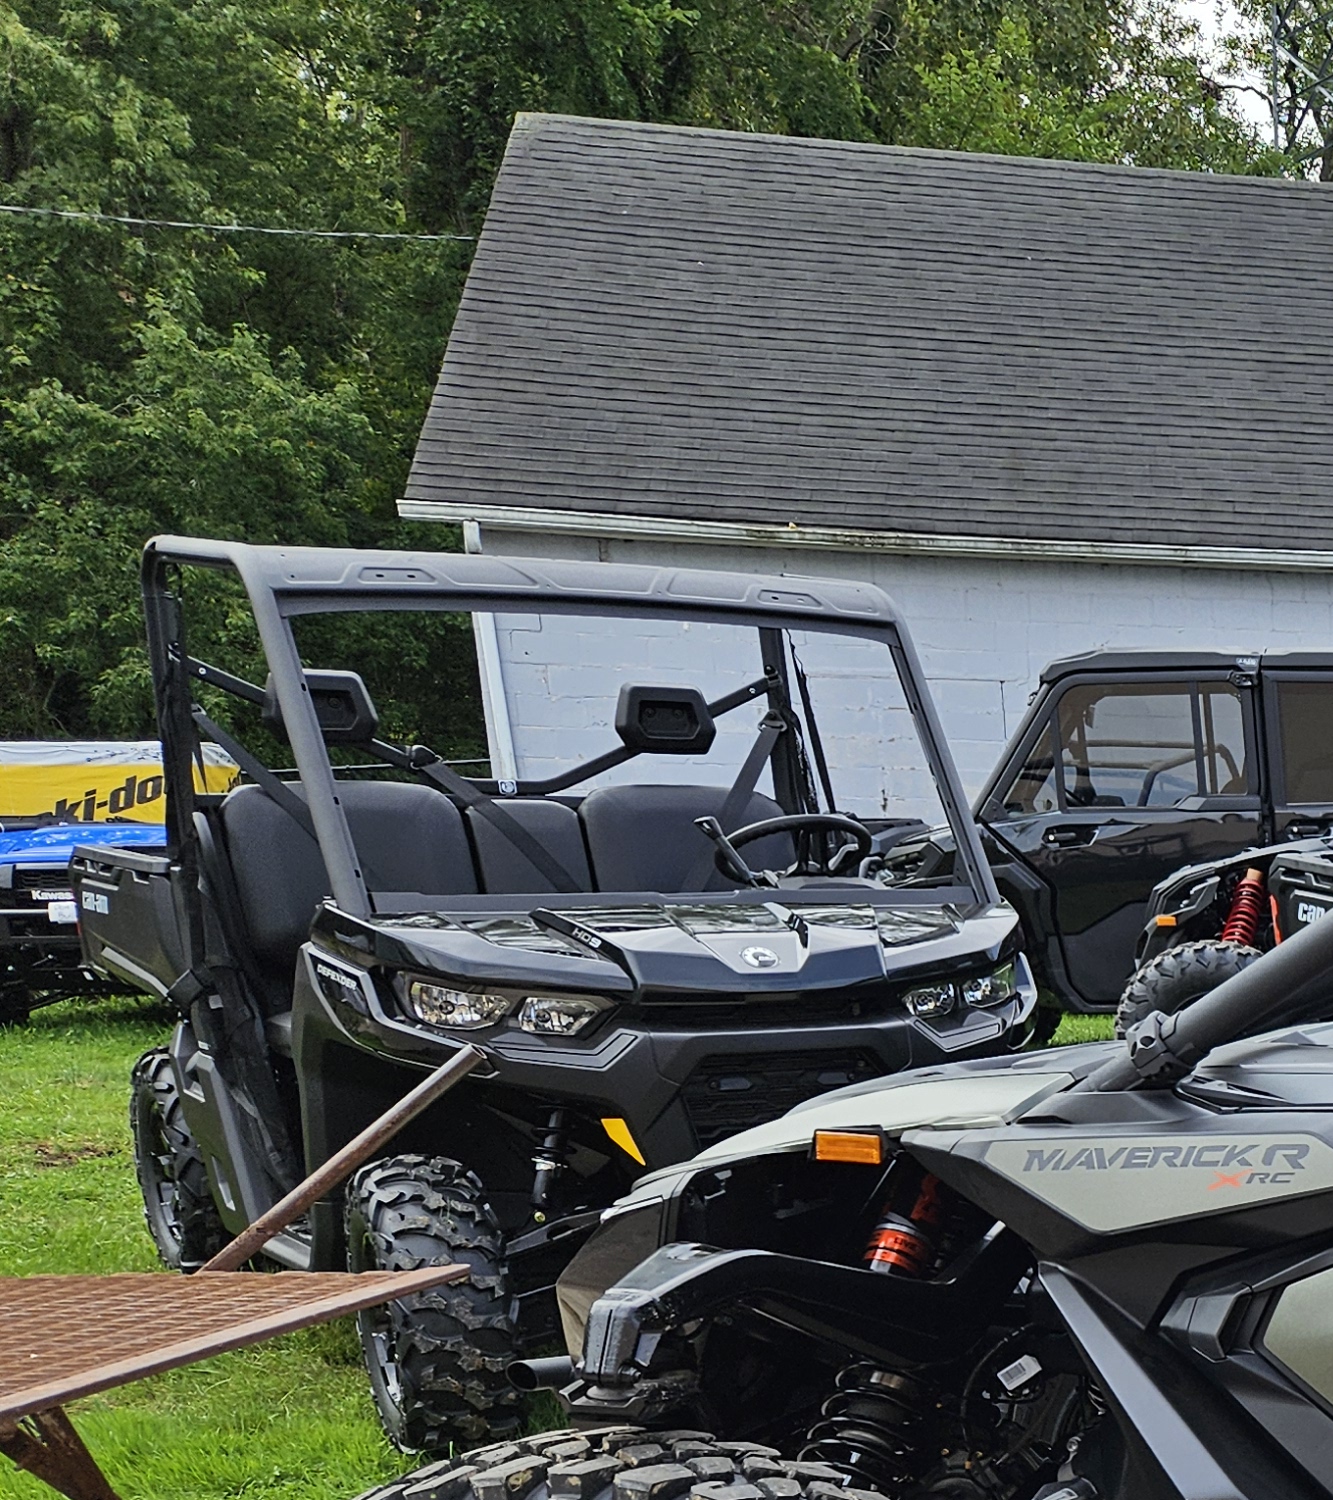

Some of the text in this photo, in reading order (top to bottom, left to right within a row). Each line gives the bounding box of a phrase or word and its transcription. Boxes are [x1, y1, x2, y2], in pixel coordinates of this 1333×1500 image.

[316, 963, 358, 991] DEFENDER
[1022, 1143, 1310, 1171] MAVERICK R
